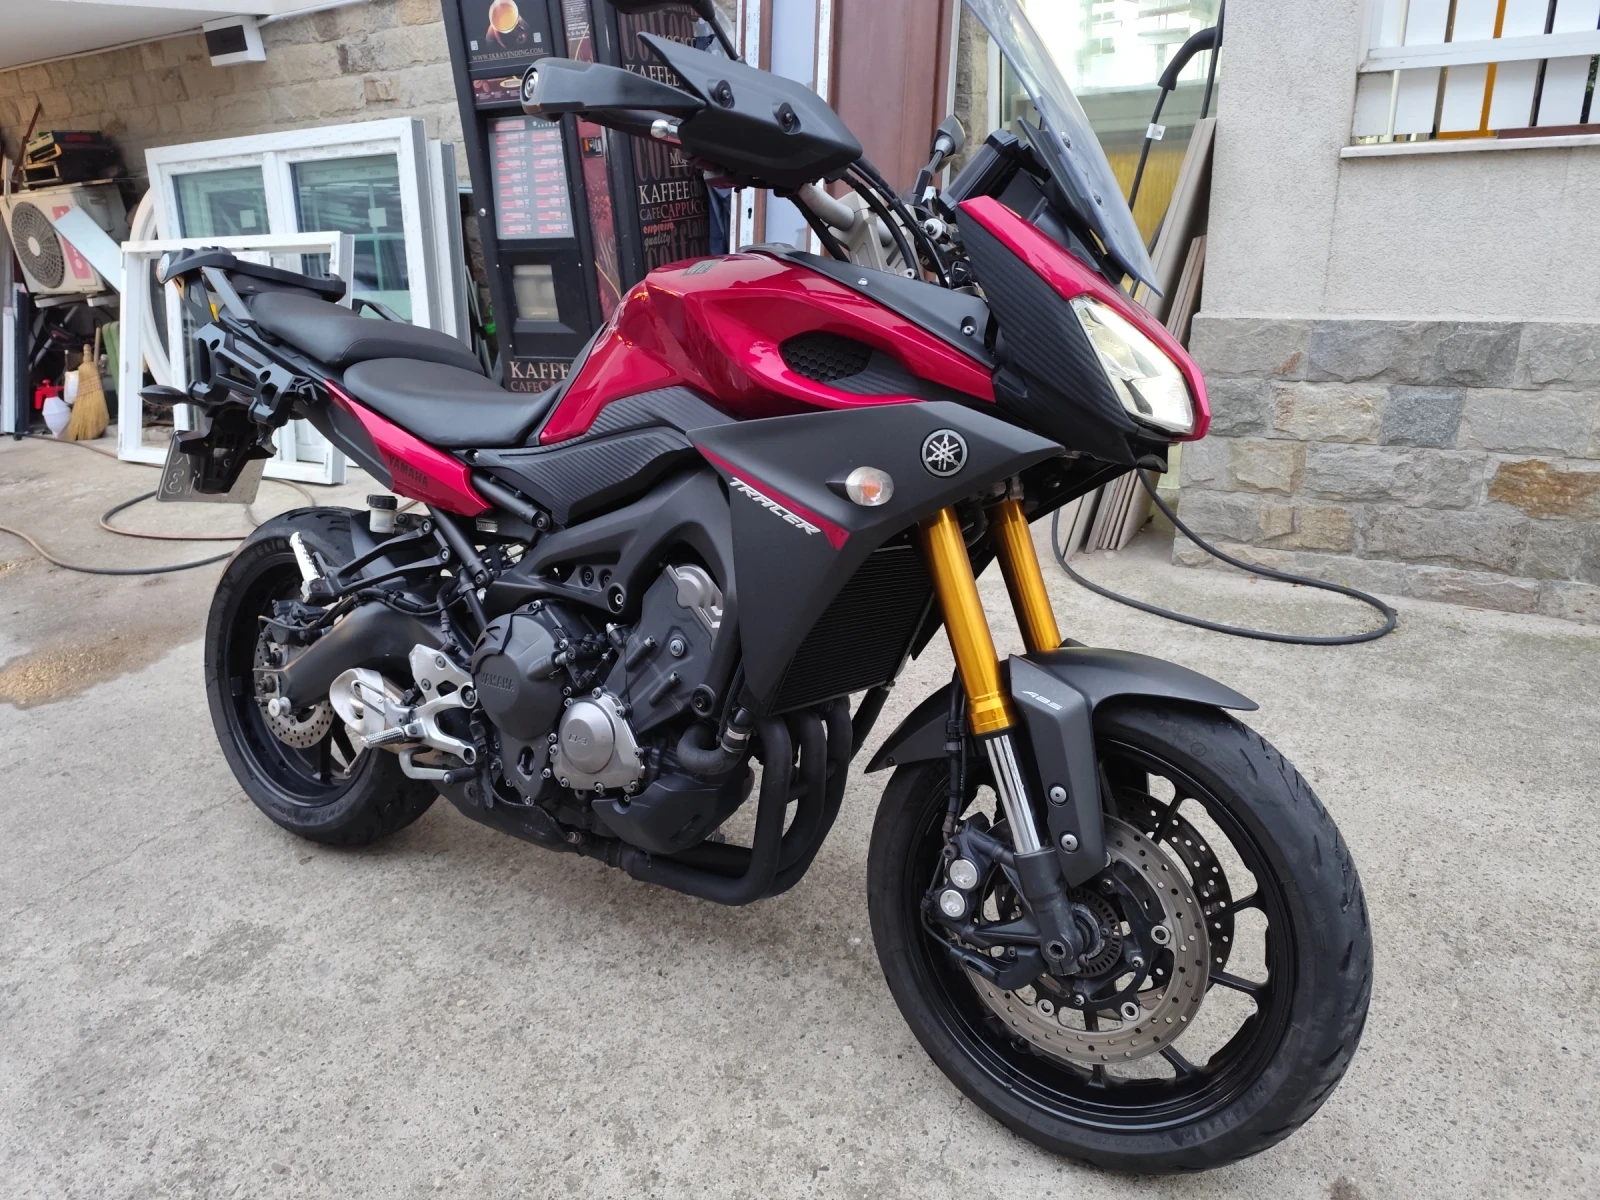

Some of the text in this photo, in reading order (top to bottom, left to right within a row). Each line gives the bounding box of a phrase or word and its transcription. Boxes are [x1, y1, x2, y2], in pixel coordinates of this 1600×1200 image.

[638, 181, 690, 205] KAFFEE
[644, 232, 671, 251] quality
[509, 361, 573, 380] KAFFE
[389, 455, 429, 488] YAMAHA
[729, 476, 821, 536] TRACER
[481, 672, 515, 692] YAMAHA
[1021, 690, 1064, 711] ABS
